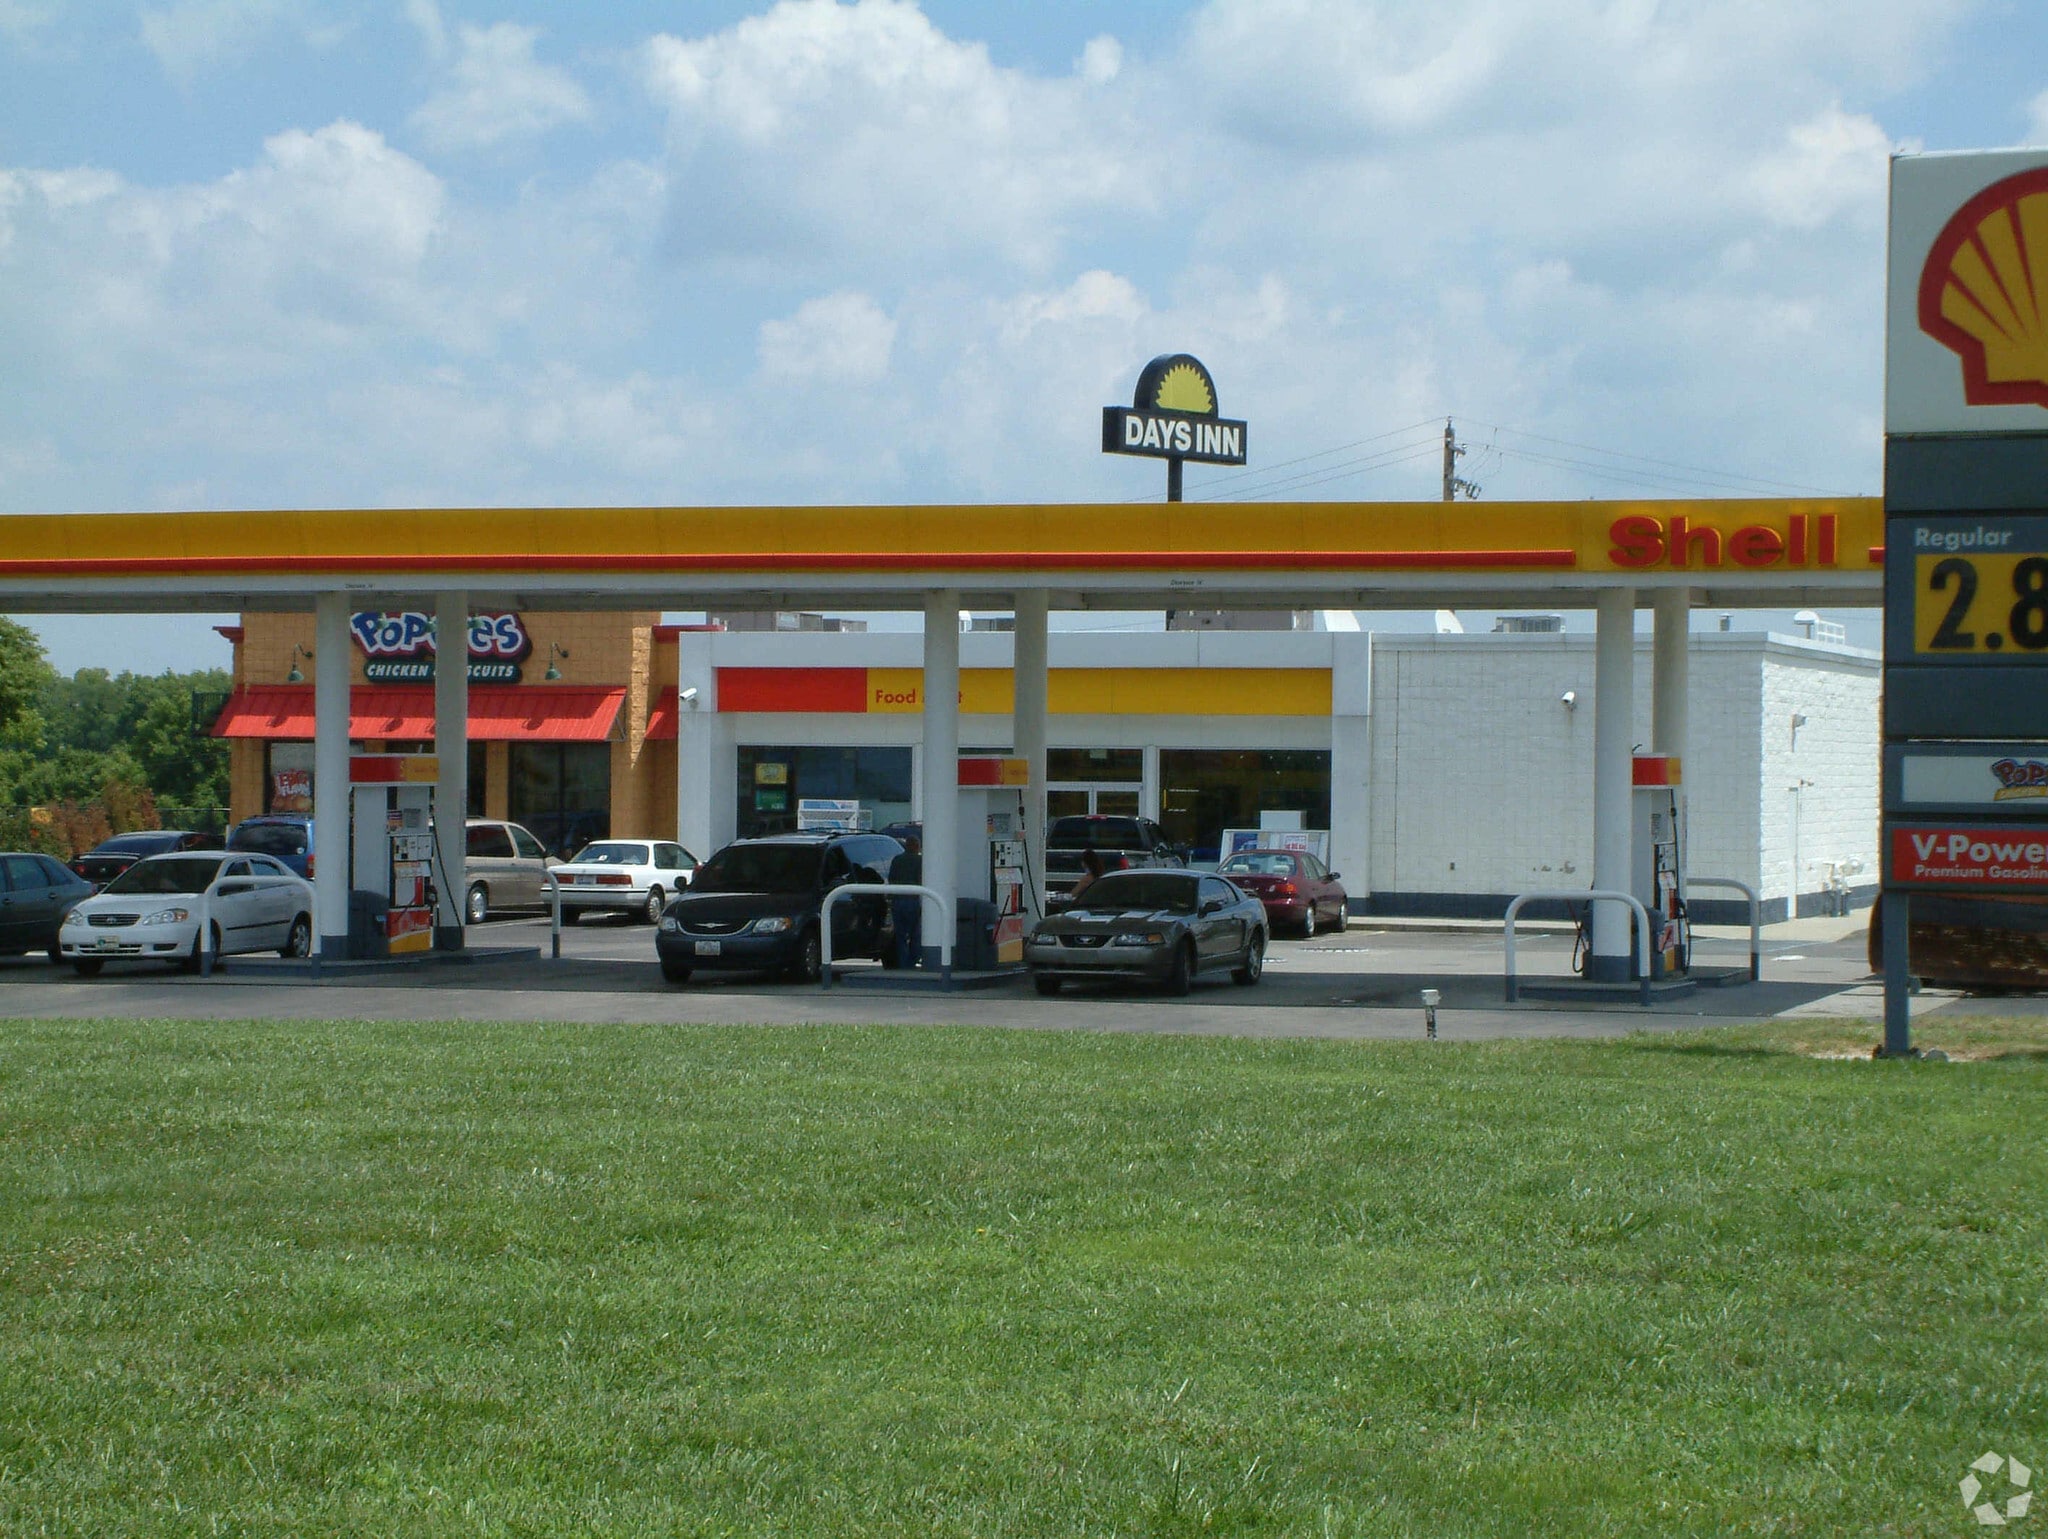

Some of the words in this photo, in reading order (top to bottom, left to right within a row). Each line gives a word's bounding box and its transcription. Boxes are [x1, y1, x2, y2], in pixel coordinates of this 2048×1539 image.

[1125, 415, 1192, 452] DAYS
[1196, 423, 1240, 457] INN
[1607, 514, 1838, 568] Shell
[1914, 526, 2012, 551] Regular
[367, 664, 429, 678] CHICKEN
[467, 665, 515, 678] SCUITS
[876, 688, 916, 704] Food
[1912, 834, 2048, 863] V-Powe
[1915, 864, 1984, 878] Premium
